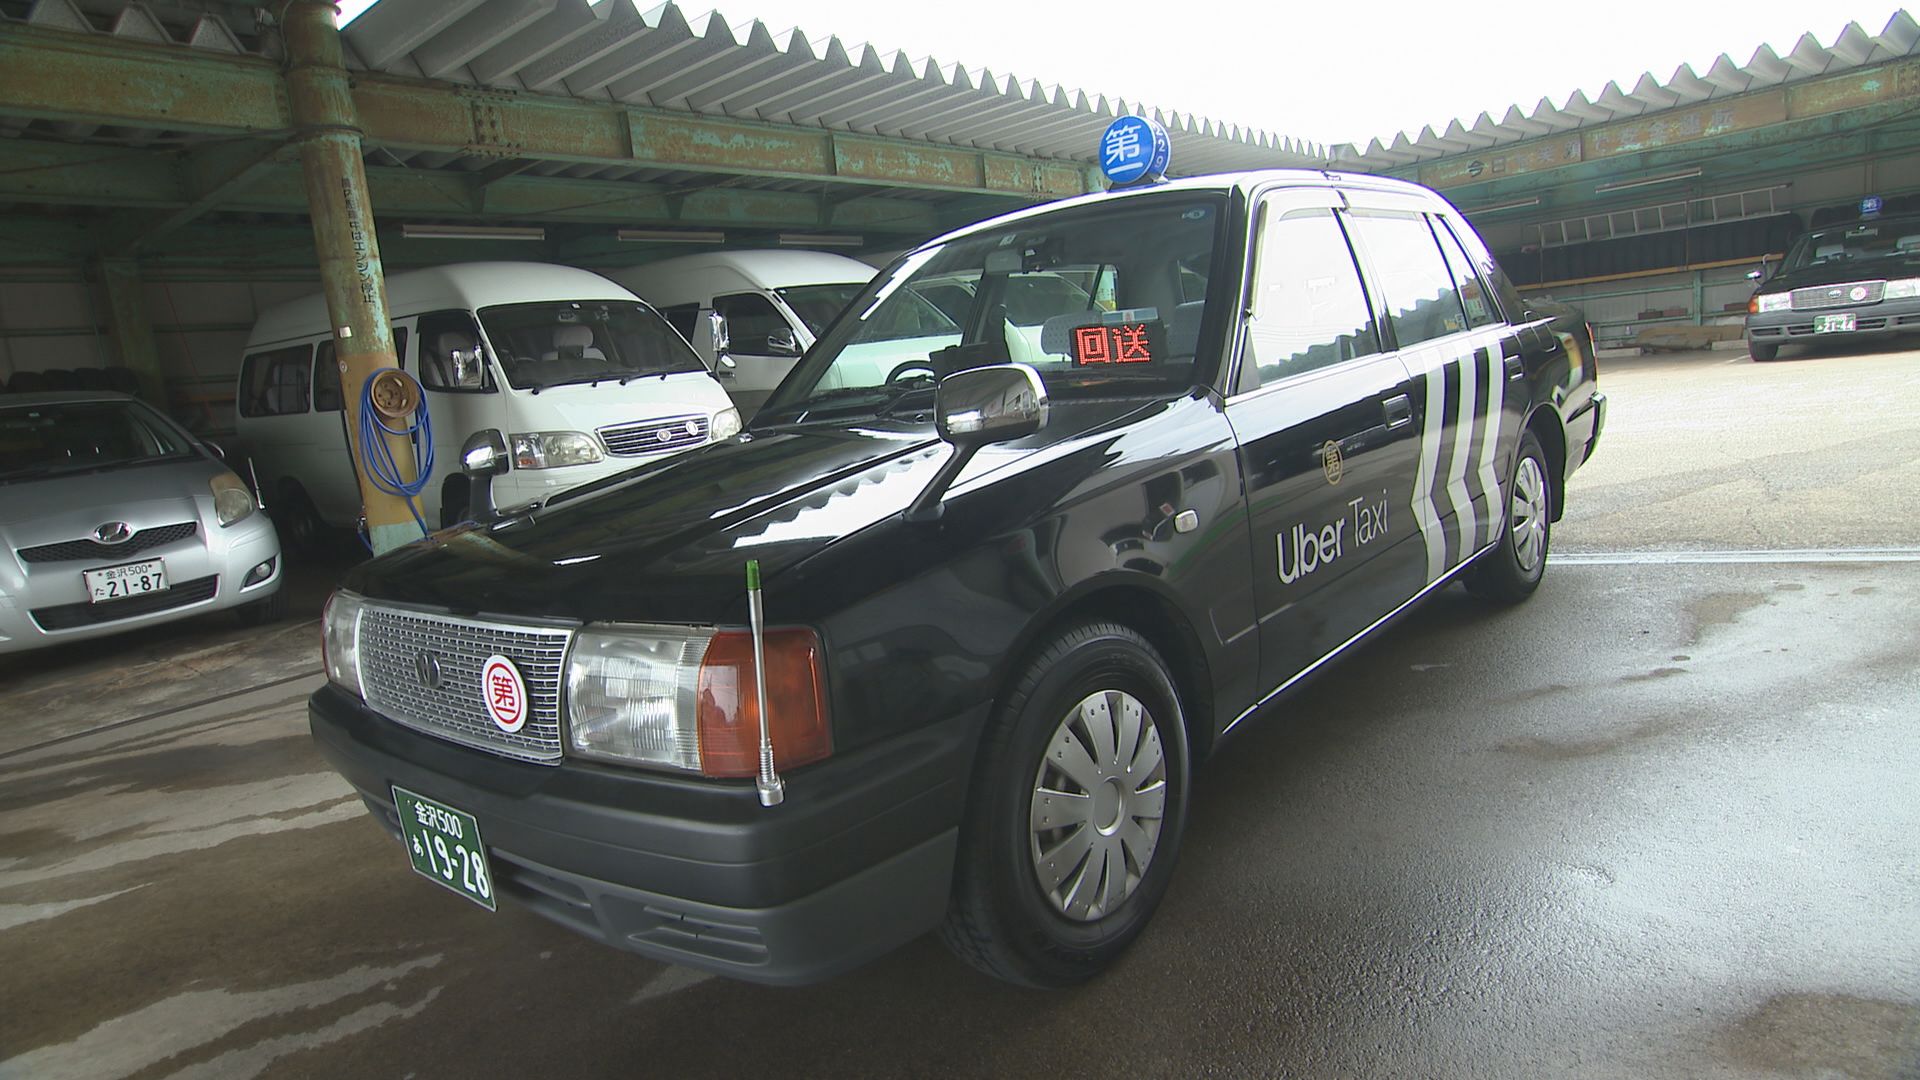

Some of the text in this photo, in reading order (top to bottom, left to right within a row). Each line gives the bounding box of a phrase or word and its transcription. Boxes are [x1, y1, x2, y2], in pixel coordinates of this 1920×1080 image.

[1106, 125, 1143, 175] 第一
[1076, 324, 1151, 365] 回送
[1326, 444, 1341, 478] 第一
[1276, 488, 1388, 584] Uber Taxi
[106, 573, 162, 597] 21-87
[491, 674, 517, 714] 第一
[422, 829, 490, 899] 19-28
